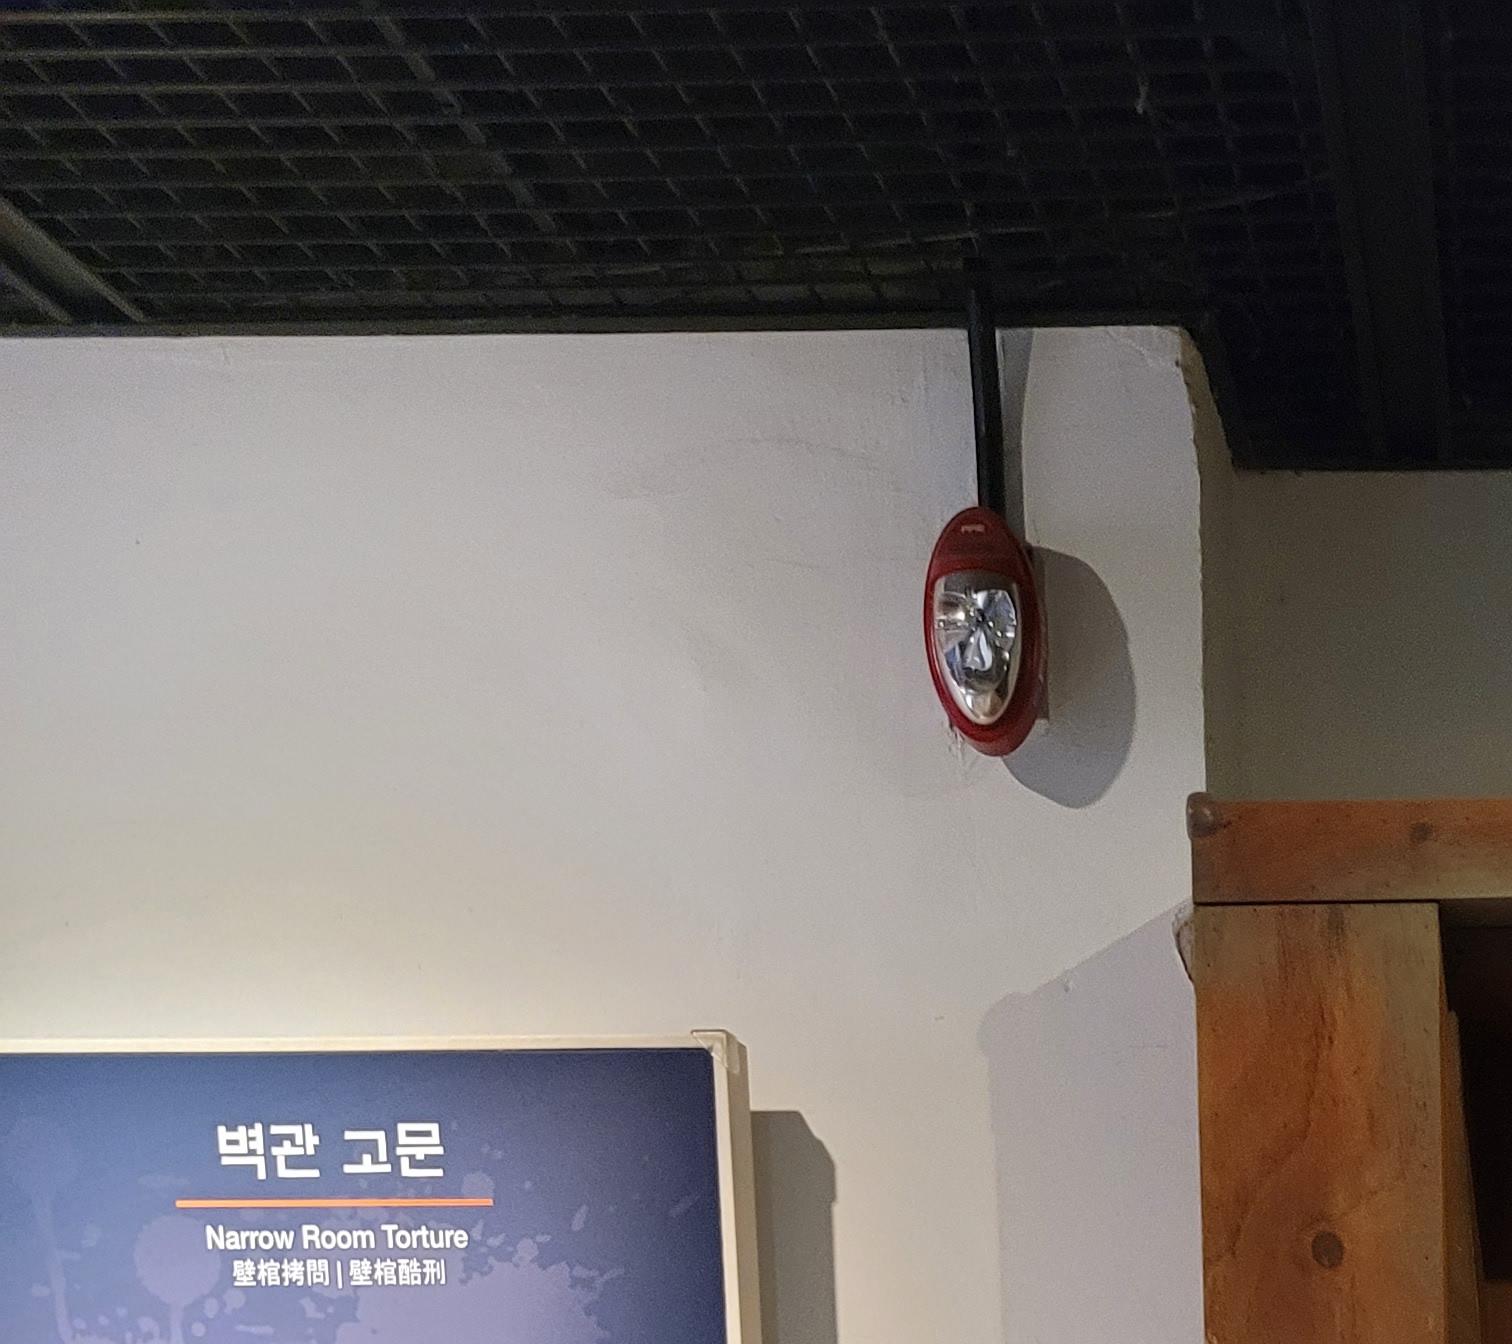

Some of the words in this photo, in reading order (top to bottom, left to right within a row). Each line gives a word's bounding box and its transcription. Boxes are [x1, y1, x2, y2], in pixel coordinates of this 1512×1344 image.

[216, 1122, 321, 1181] 벽관
[342, 1122, 445, 1178] 고문
[205, 1224, 295, 1250] Narrow
[301, 1224, 376, 1250] Room
[380, 1223, 469, 1249] Torture
[233, 1257, 330, 1287] 壁棺拷問
[348, 1257, 446, 1286] 壁棺酷刑
